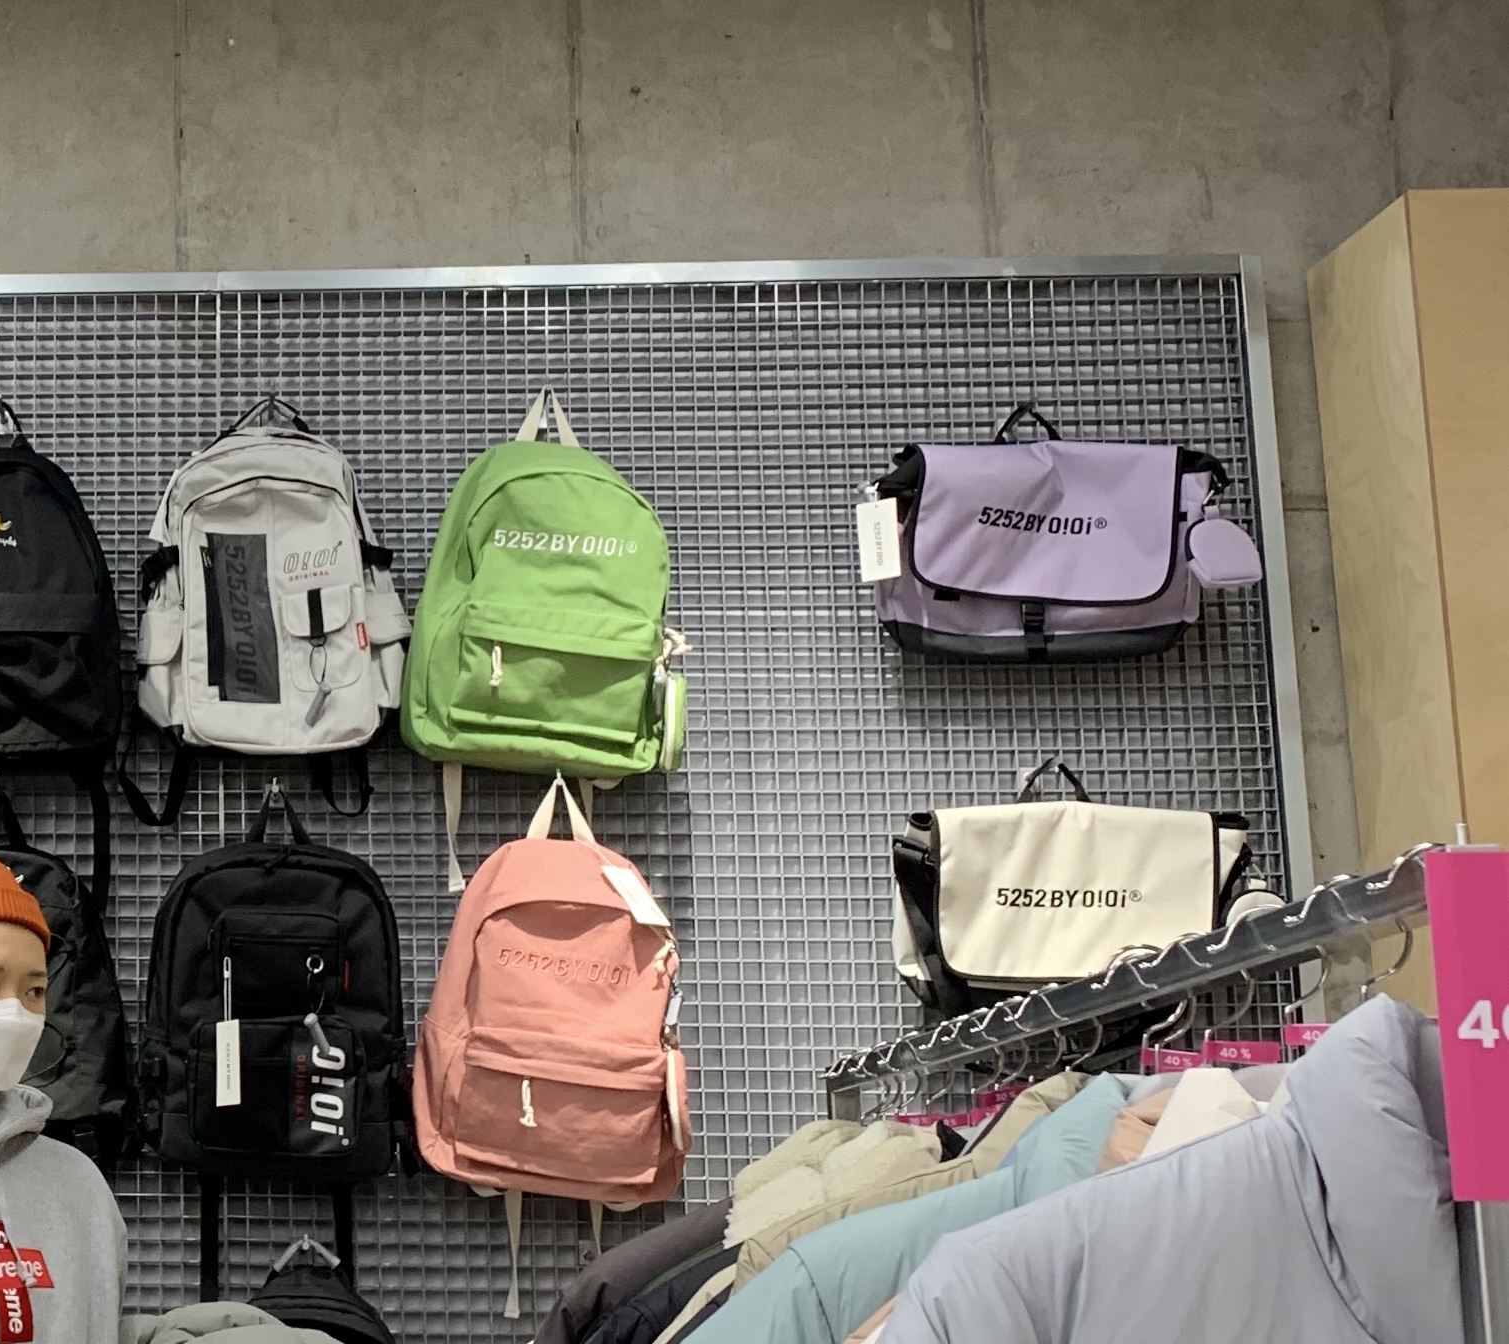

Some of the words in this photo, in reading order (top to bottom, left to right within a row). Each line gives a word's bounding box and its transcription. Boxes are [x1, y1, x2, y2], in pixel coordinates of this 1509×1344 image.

[978, 506, 1046, 533] 5252BY
[493, 528, 580, 554] 5252BY
[995, 887, 1079, 909] 5252BY
[1457, 999, 1509, 1049] 4
[1164, 1055, 1181, 1067] 40
[1219, 1047, 1238, 1059] 40
[1239, 1047, 1252, 1060] %
